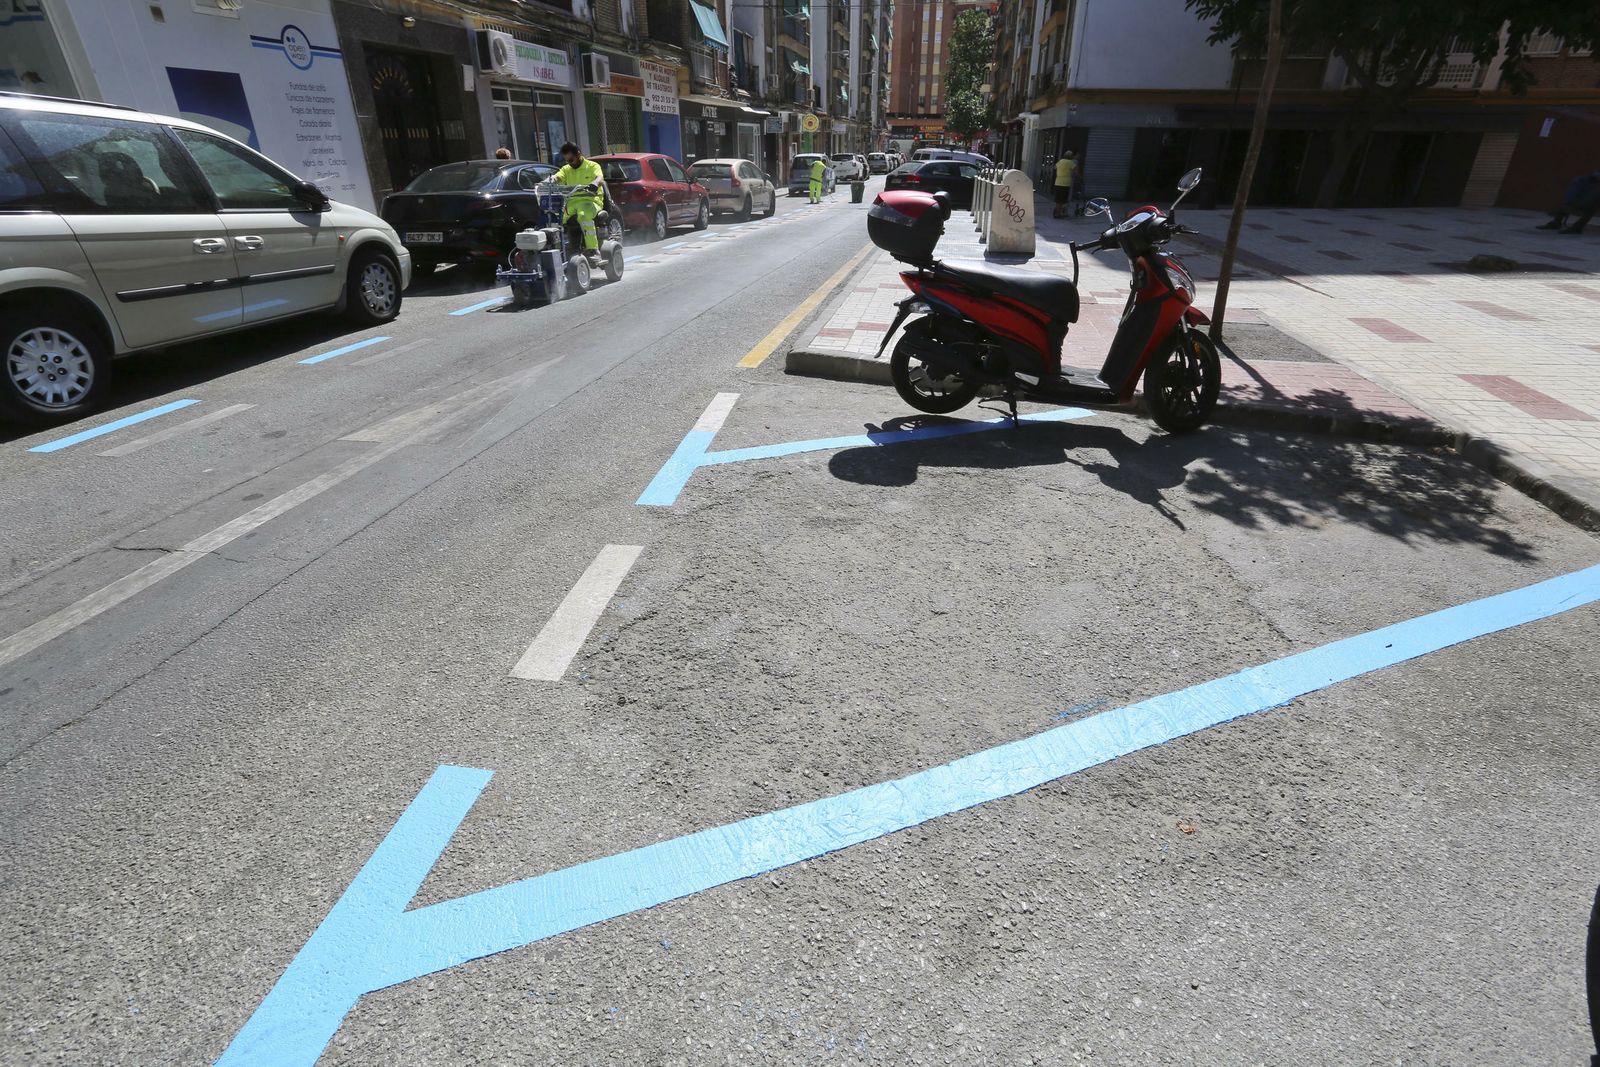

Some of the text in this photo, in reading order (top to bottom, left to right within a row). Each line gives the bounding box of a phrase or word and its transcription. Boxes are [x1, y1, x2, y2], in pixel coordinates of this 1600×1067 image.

[640, 61, 658, 72] PARKING
[533, 66, 555, 80] ISABEL
[653, 74, 670, 84] ALQUILER
[646, 81, 652, 90] DE
[652, 82, 673, 93] TRASTEROS
